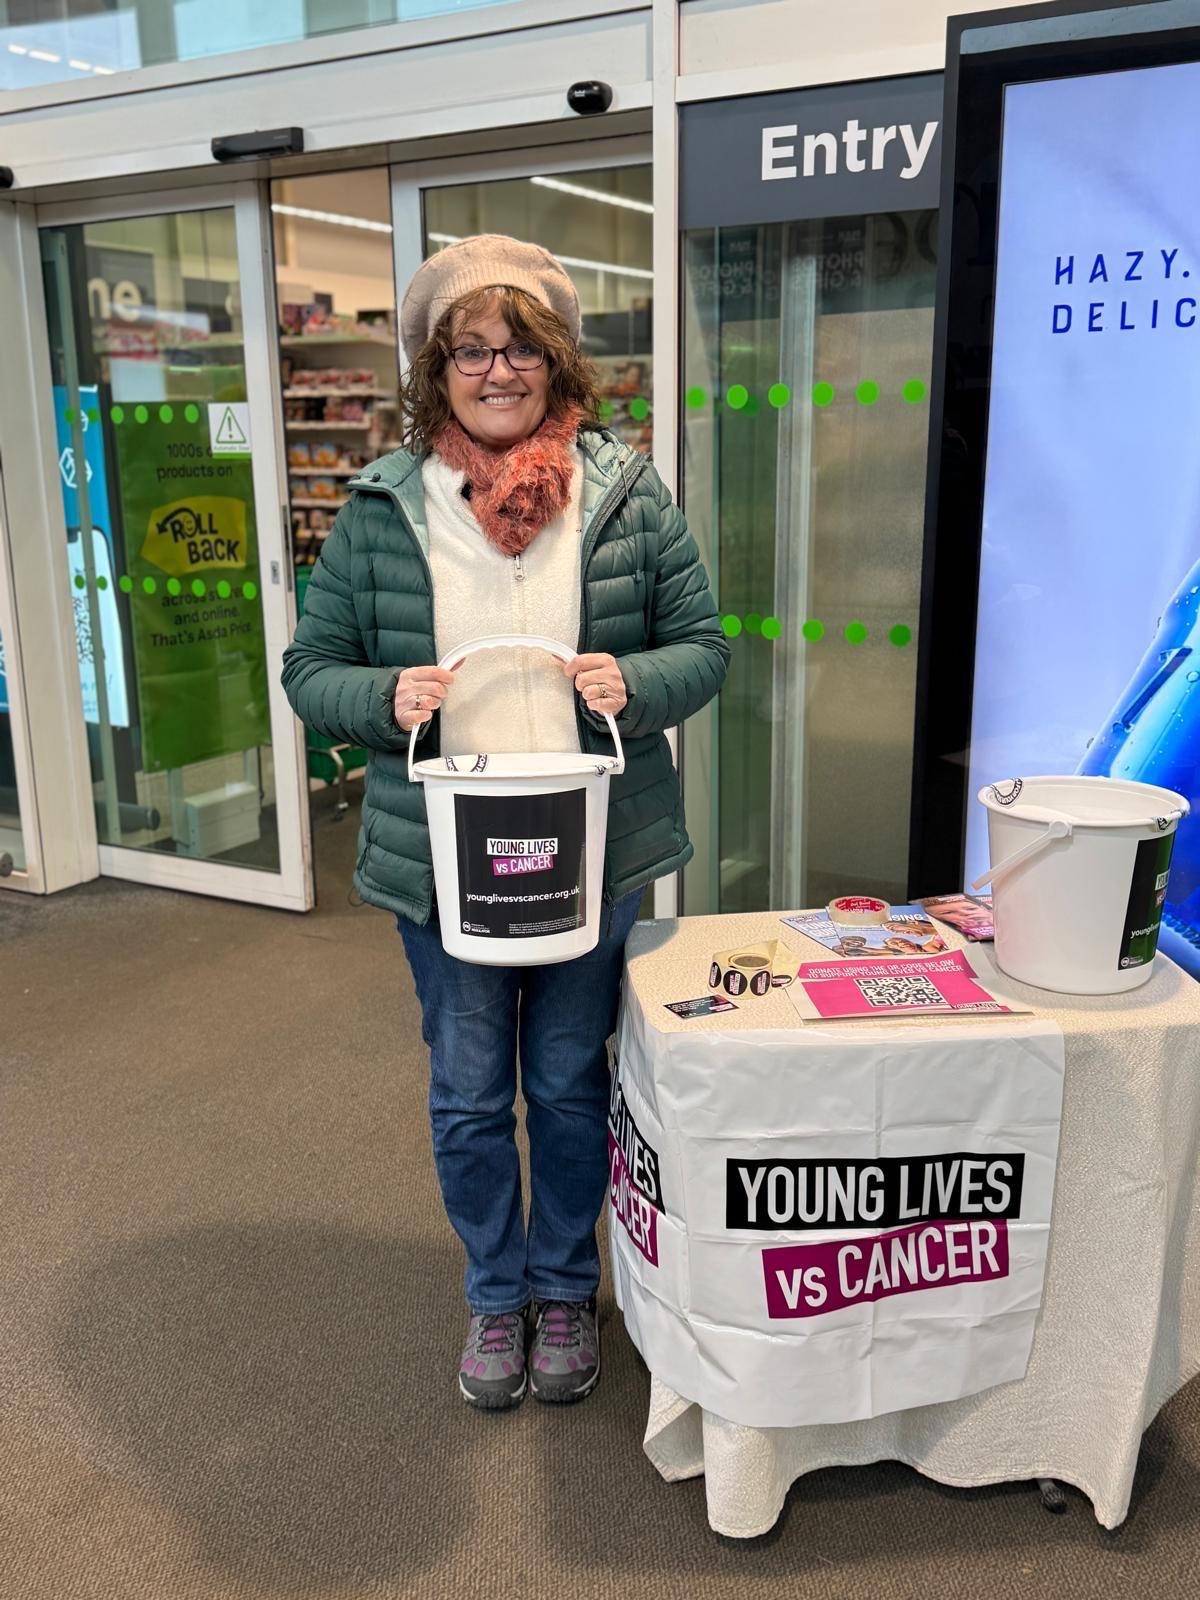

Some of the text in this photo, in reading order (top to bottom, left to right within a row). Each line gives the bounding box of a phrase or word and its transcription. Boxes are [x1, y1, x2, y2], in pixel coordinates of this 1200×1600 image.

[761, 119, 939, 181] Entry
[1055, 248, 1190, 285] HAZY.
[1052, 297, 1197, 334] DELIC
[167, 443, 203, 458] 1000s
[157, 465, 233, 483] products on
[170, 511, 218, 543] ROLL
[174, 609, 199, 625] and
[151, 630, 195, 647] That's
[198, 626, 228, 641] Asda
[490, 840, 556, 854] YOUNG LIVES
[510, 855, 551, 872] CANCER
[466, 886, 580, 904] younglivesvscancer.org.uk
[808, 967, 841, 975] DONATE
[843, 965, 870, 974] USING
[871, 964, 885, 972] THE
[901, 962, 923, 970] CODE
[925, 959, 955, 968] BELOW
[818, 971, 859, 979] SUPPORT
[860, 969, 889, 977] YOUNG
[929, 965, 964, 973] CANCER
[738, 1160, 1013, 1223] YOUNG LIVES
[836, 1219, 1000, 1299] CANCER
